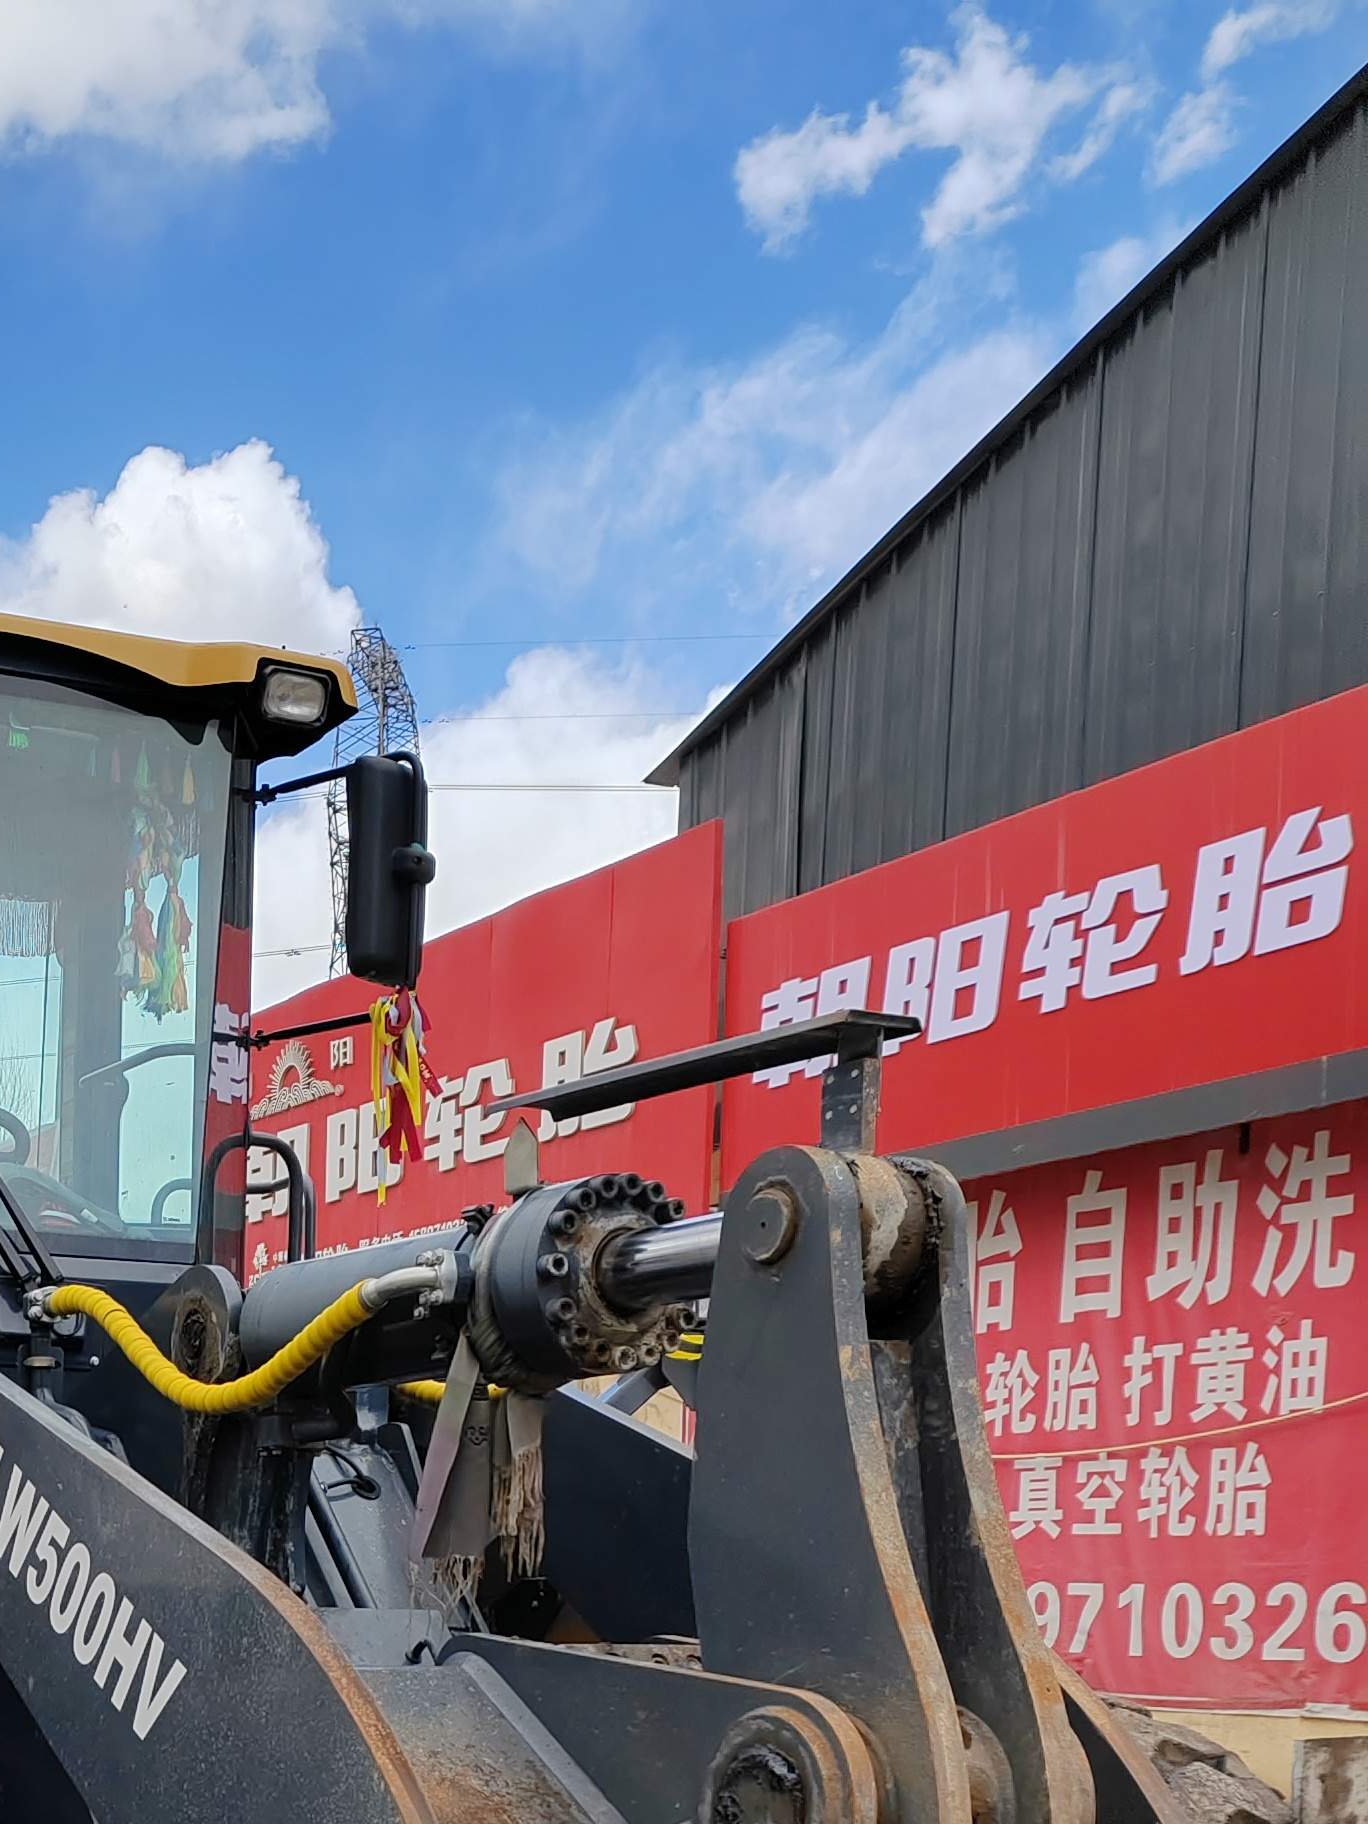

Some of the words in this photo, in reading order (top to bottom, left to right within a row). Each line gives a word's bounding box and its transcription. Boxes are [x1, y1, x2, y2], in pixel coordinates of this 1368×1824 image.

[330, 1036, 353, 1069] 阳
[1009, 1441, 1272, 1540] 真空轮胎
